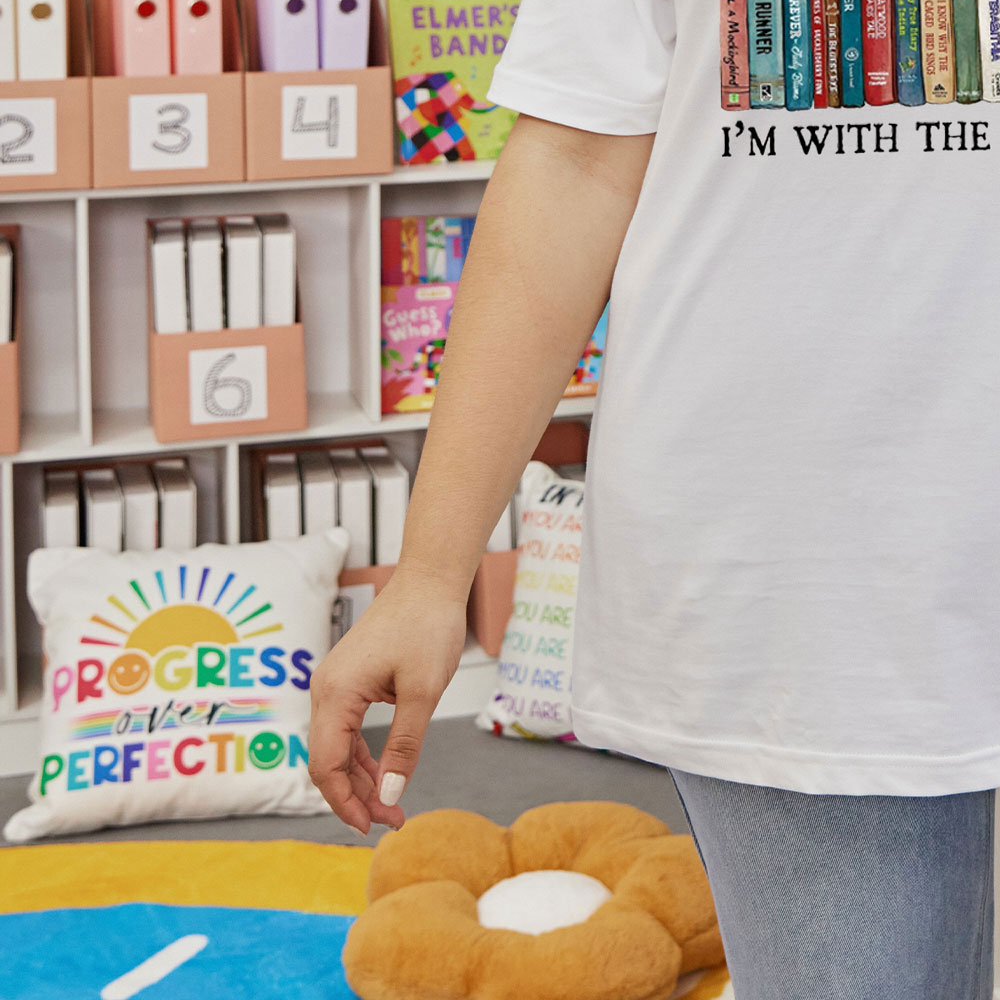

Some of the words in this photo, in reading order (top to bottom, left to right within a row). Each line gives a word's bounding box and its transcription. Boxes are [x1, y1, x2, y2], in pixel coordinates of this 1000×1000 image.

[755, 2, 773, 55] RUNNER
[828, 23, 837, 39] THE
[924, 0, 935, 28] CAGED
[430, 33, 508, 58] BAND
[828, 40, 838, 73] BLUEST
[925, 32, 936, 51] BIRD
[926, 52, 936, 76] SINGS
[939, 55, 949, 72] THE
[0, 113, 34, 164] 2
[152, 103, 193, 154] 3
[291, 95, 340, 148] 4
[721, 120, 777, 158] I'M
[793, 122, 899, 156] WITH
[916, 121, 991, 153] THE
[383, 305, 438, 327] Guess
[388, 318, 443, 343] Who?
[202, 352, 253, 419] 6
[52, 647, 313, 713] PROGRESS
[115, 698, 250, 736] over
[39, 730, 310, 797] PERFECTION
